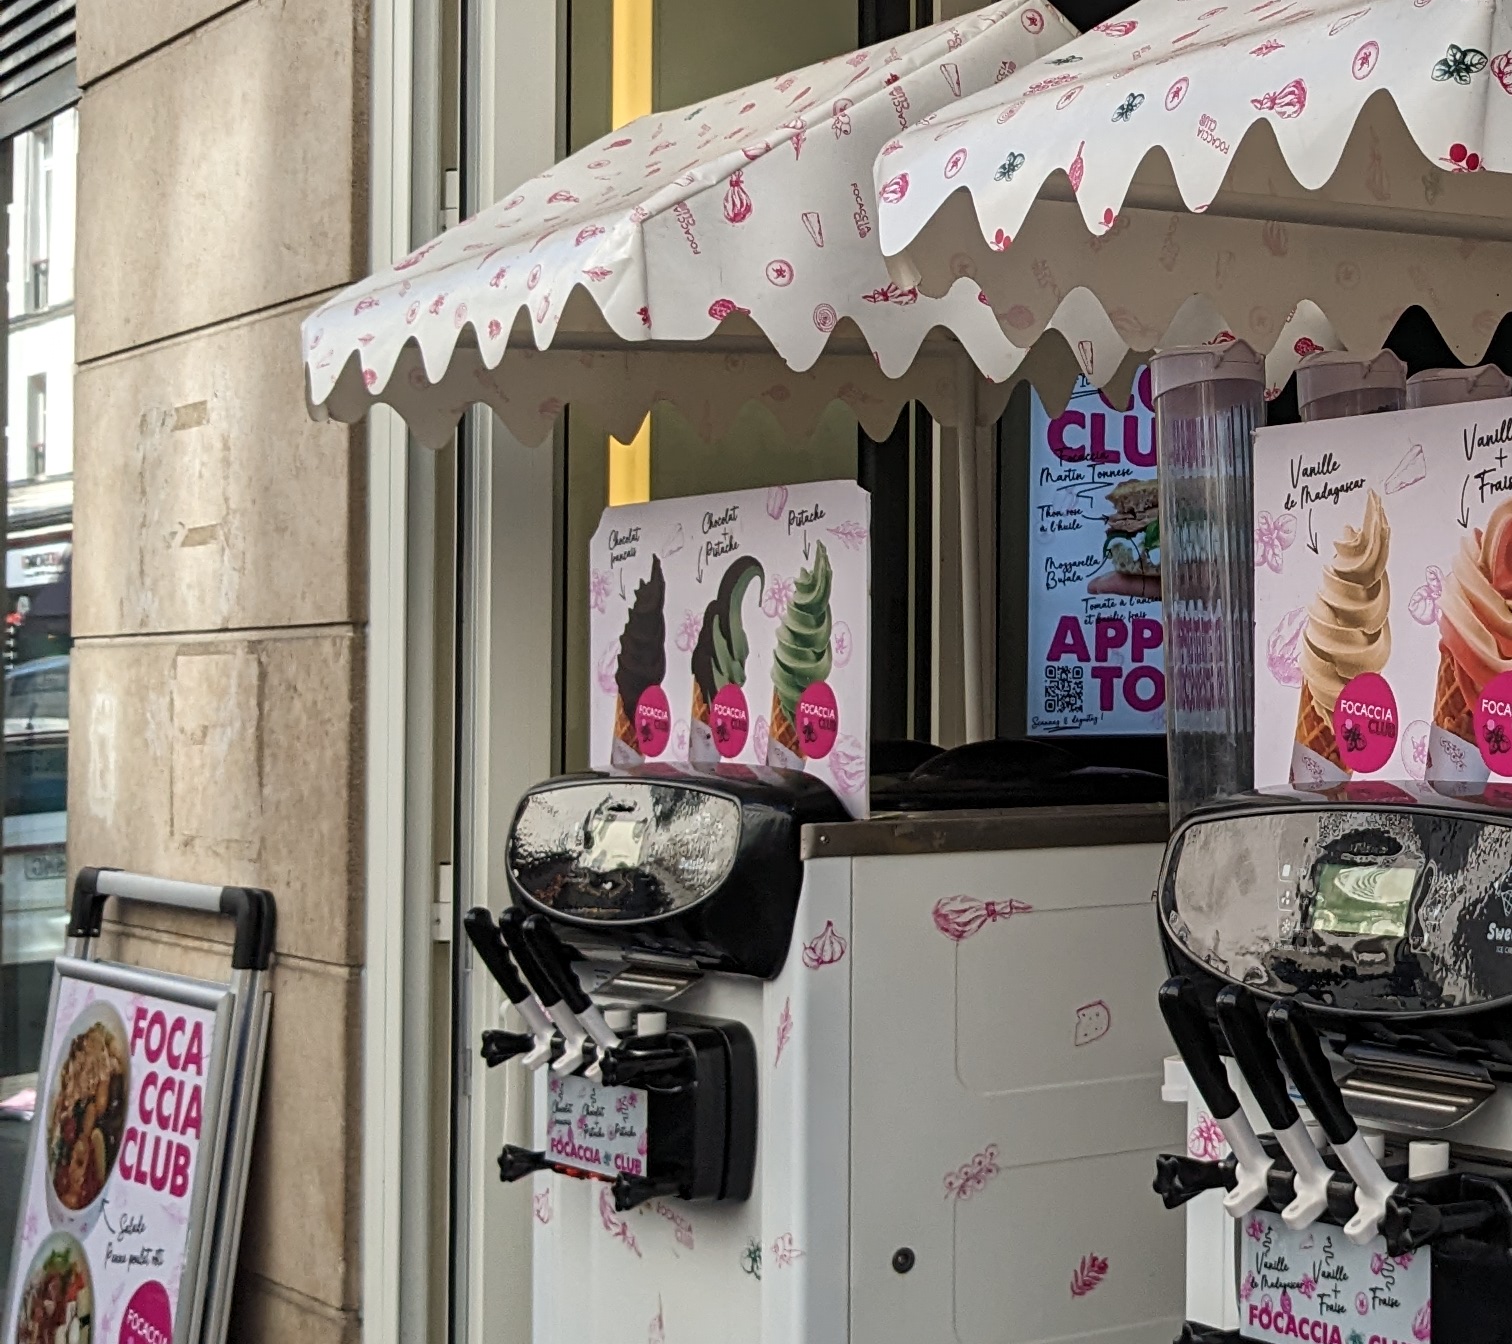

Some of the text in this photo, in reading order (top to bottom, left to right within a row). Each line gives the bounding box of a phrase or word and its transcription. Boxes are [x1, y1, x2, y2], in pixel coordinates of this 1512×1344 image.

[1197, 127, 1230, 155] FOCACCIA
[850, 182, 871, 233] FOCACCIA
[673, 207, 701, 255] FOCACCIA
[1047, 410, 1158, 467] CLU
[1040, 467, 1086, 487] Martin
[1290, 452, 1341, 489] Vanille
[1284, 478, 1366, 511] de Madagascar
[702, 506, 739, 534] Chocolat
[788, 504, 826, 534] Pistache
[1037, 505, 1063, 521] Thon
[608, 526, 641, 550] Chocolat
[706, 534, 739, 565] Pistache
[1045, 555, 1100, 573] Mozzarella
[1046, 571, 1083, 590] Bufala
[1081, 597, 1117, 614] Tomate
[1084, 614, 1095, 625] et
[638, 704, 668, 720] FOCACCIA
[714, 704, 747, 720] FOCACCIA
[800, 703, 835, 719] FOCACCIA
[1340, 699, 1393, 721] FOCACCIA
[1368, 719, 1396, 739] CLUB
[131, 1006, 203, 1076] FOCA
[139, 1071, 202, 1140] CCIA
[119, 1127, 190, 1197] CLUB
[551, 1137, 642, 1174] FOCACCIA CLUB
[1256, 1252, 1289, 1274] Vanille
[1313, 1260, 1349, 1284] Vanille
[1317, 1293, 1347, 1316] Fraise
[1369, 1287, 1401, 1310] Fraise
